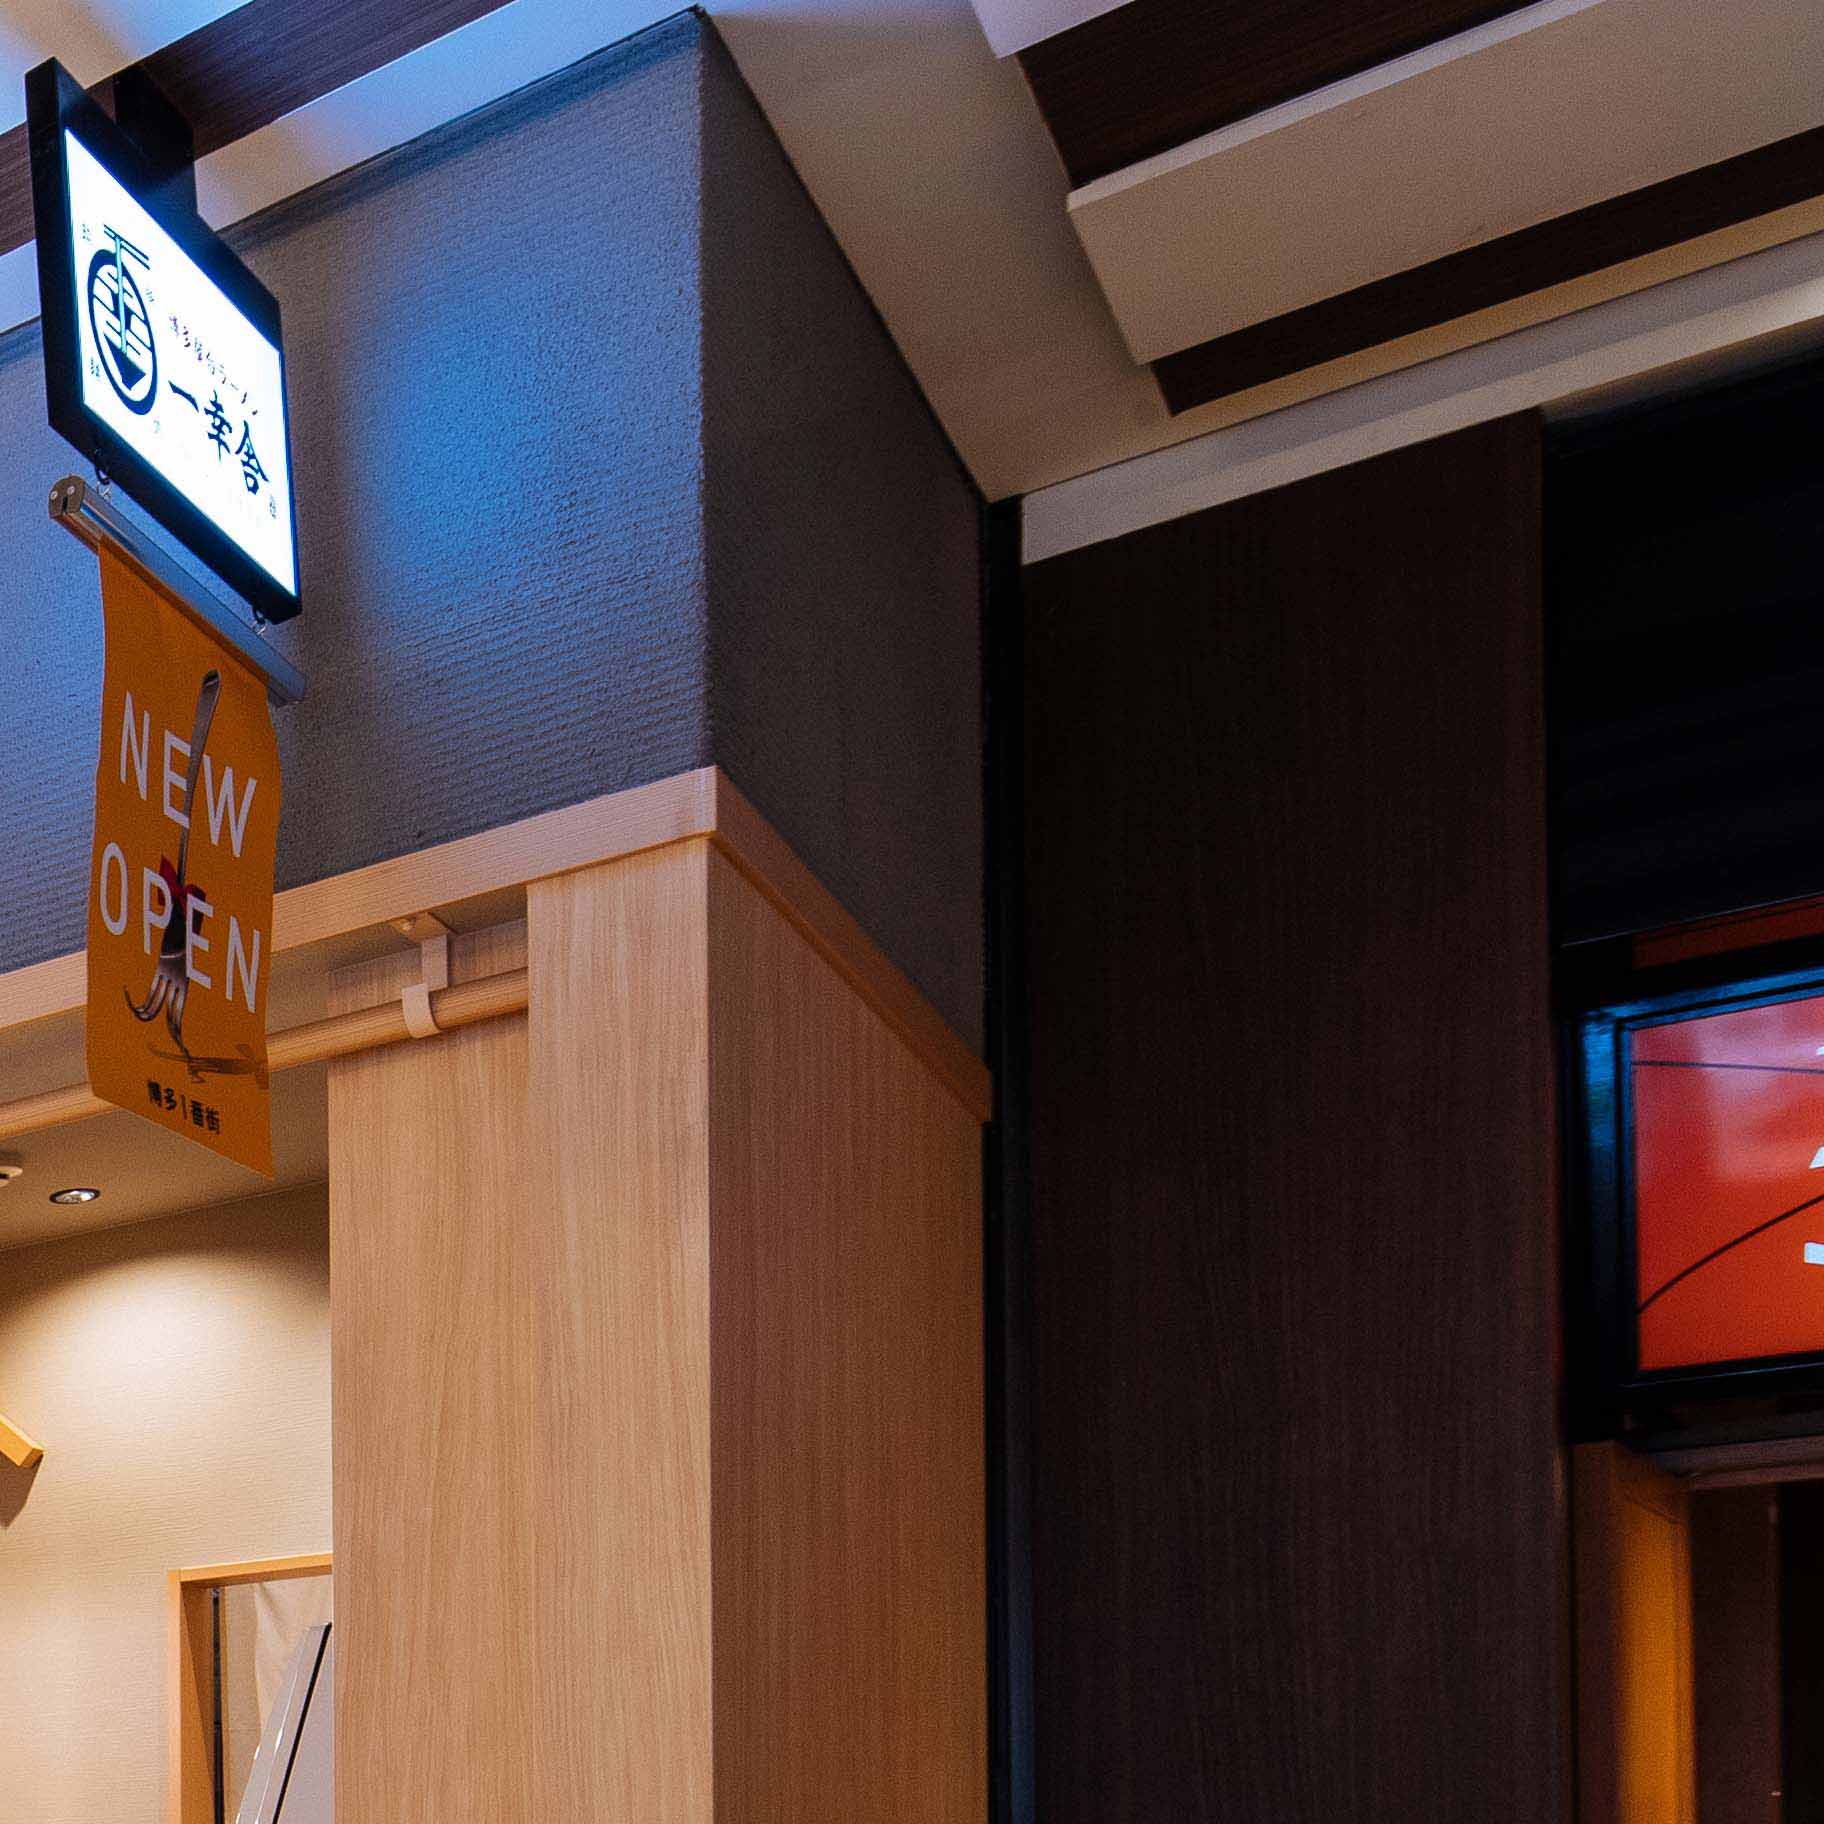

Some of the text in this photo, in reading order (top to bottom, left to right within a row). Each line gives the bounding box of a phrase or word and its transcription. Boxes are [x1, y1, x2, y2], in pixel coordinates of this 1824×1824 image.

[168, 380, 270, 496] 一幸舎
[120, 690, 258, 857] NEW
[99, 842, 261, 1014] OPEN
